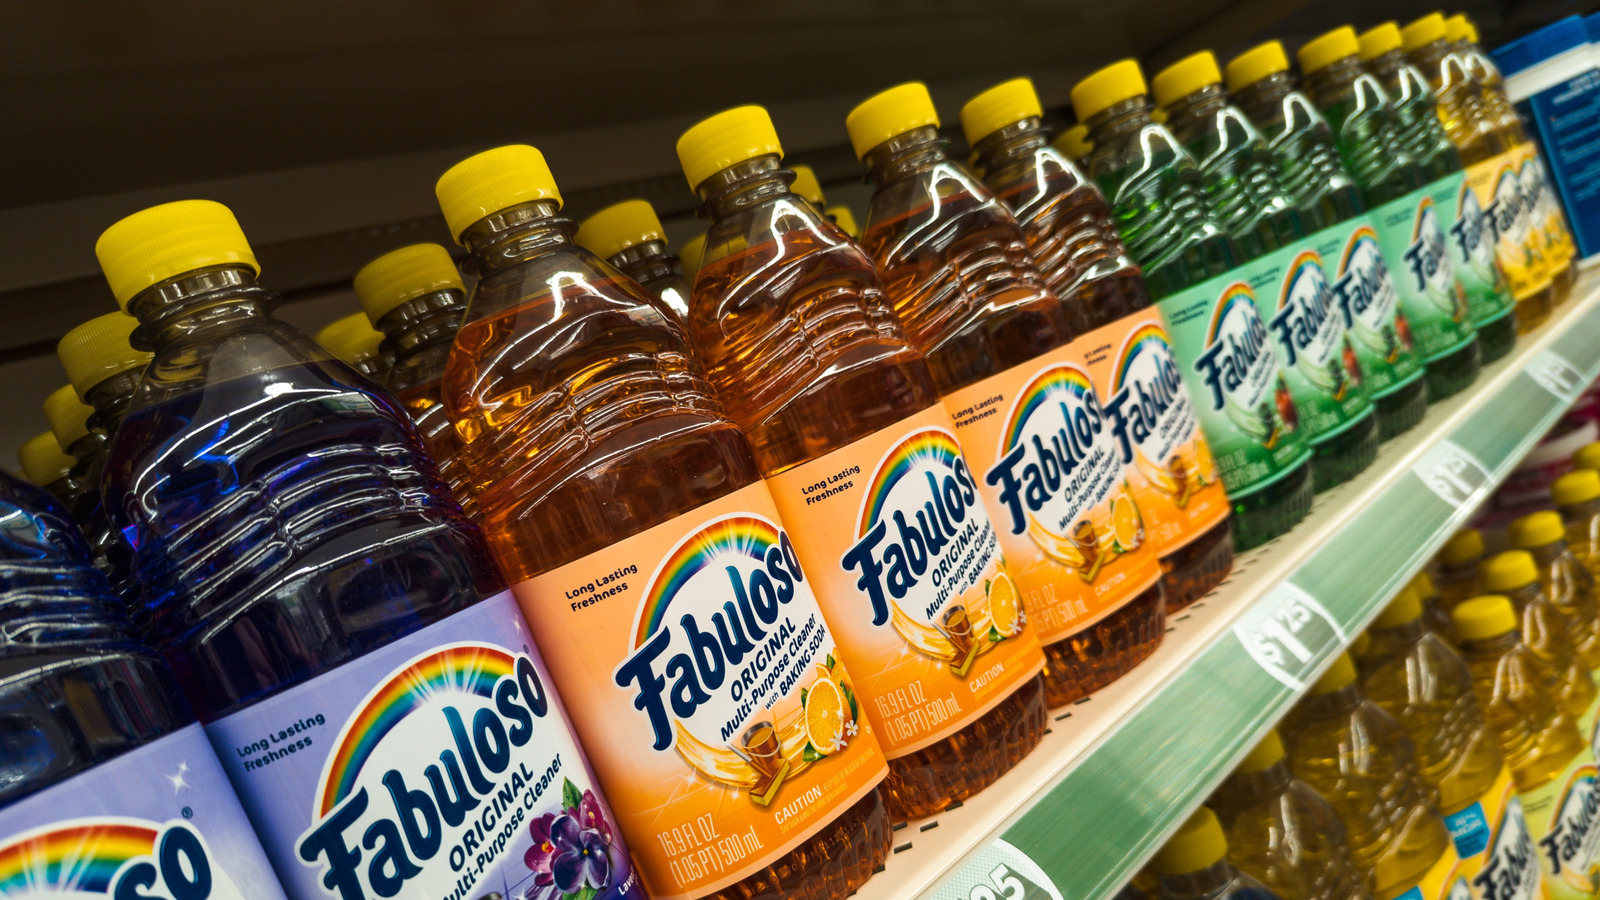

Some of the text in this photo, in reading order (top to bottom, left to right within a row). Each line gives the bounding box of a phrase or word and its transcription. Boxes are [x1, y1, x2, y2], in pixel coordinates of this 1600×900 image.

[951, 394, 1004, 420] Long Lasting
[955, 407, 997, 429] Freshness
[801, 465, 861, 495] Long Lasting
[806, 480, 854, 506] Freshness
[1064, 445, 1105, 503] ORIGINAL
[842, 456, 977, 626] Fabulos
[931, 518, 979, 587] ORIGINAL
[968, 546, 992, 585] BAKING
[565, 564, 638, 600] Long Lasting
[570, 582, 629, 612] Freshness
[925, 549, 976, 620] Multi-Purpose
[615, 530, 803, 752] Fabuloso
[731, 617, 796, 702] ORIGINAL
[764, 624, 826, 710] with BAKING SODA
[720, 613, 816, 742] Multi-Purpose Cleaner
[874, 680, 928, 719] 16.9 FL OZ
[969, 662, 1005, 693] CAUTION
[236, 713, 326, 757] Long Lasting
[883, 691, 963, 746] (1.05 PT) 500 mL
[243, 736, 313, 772] Freshness
[299, 655, 549, 900] Fabuloso
[443, 753, 563, 900] ulti-Purpose Cleaner
[449, 762, 534, 873] ORIGINAL
[657, 812, 720, 858] 16.9 FL OZ
[669, 854, 704, 889] (1.05
[697, 845, 725, 875] PT)
[717, 833, 747, 866] 500
[742, 825, 764, 855] mL
